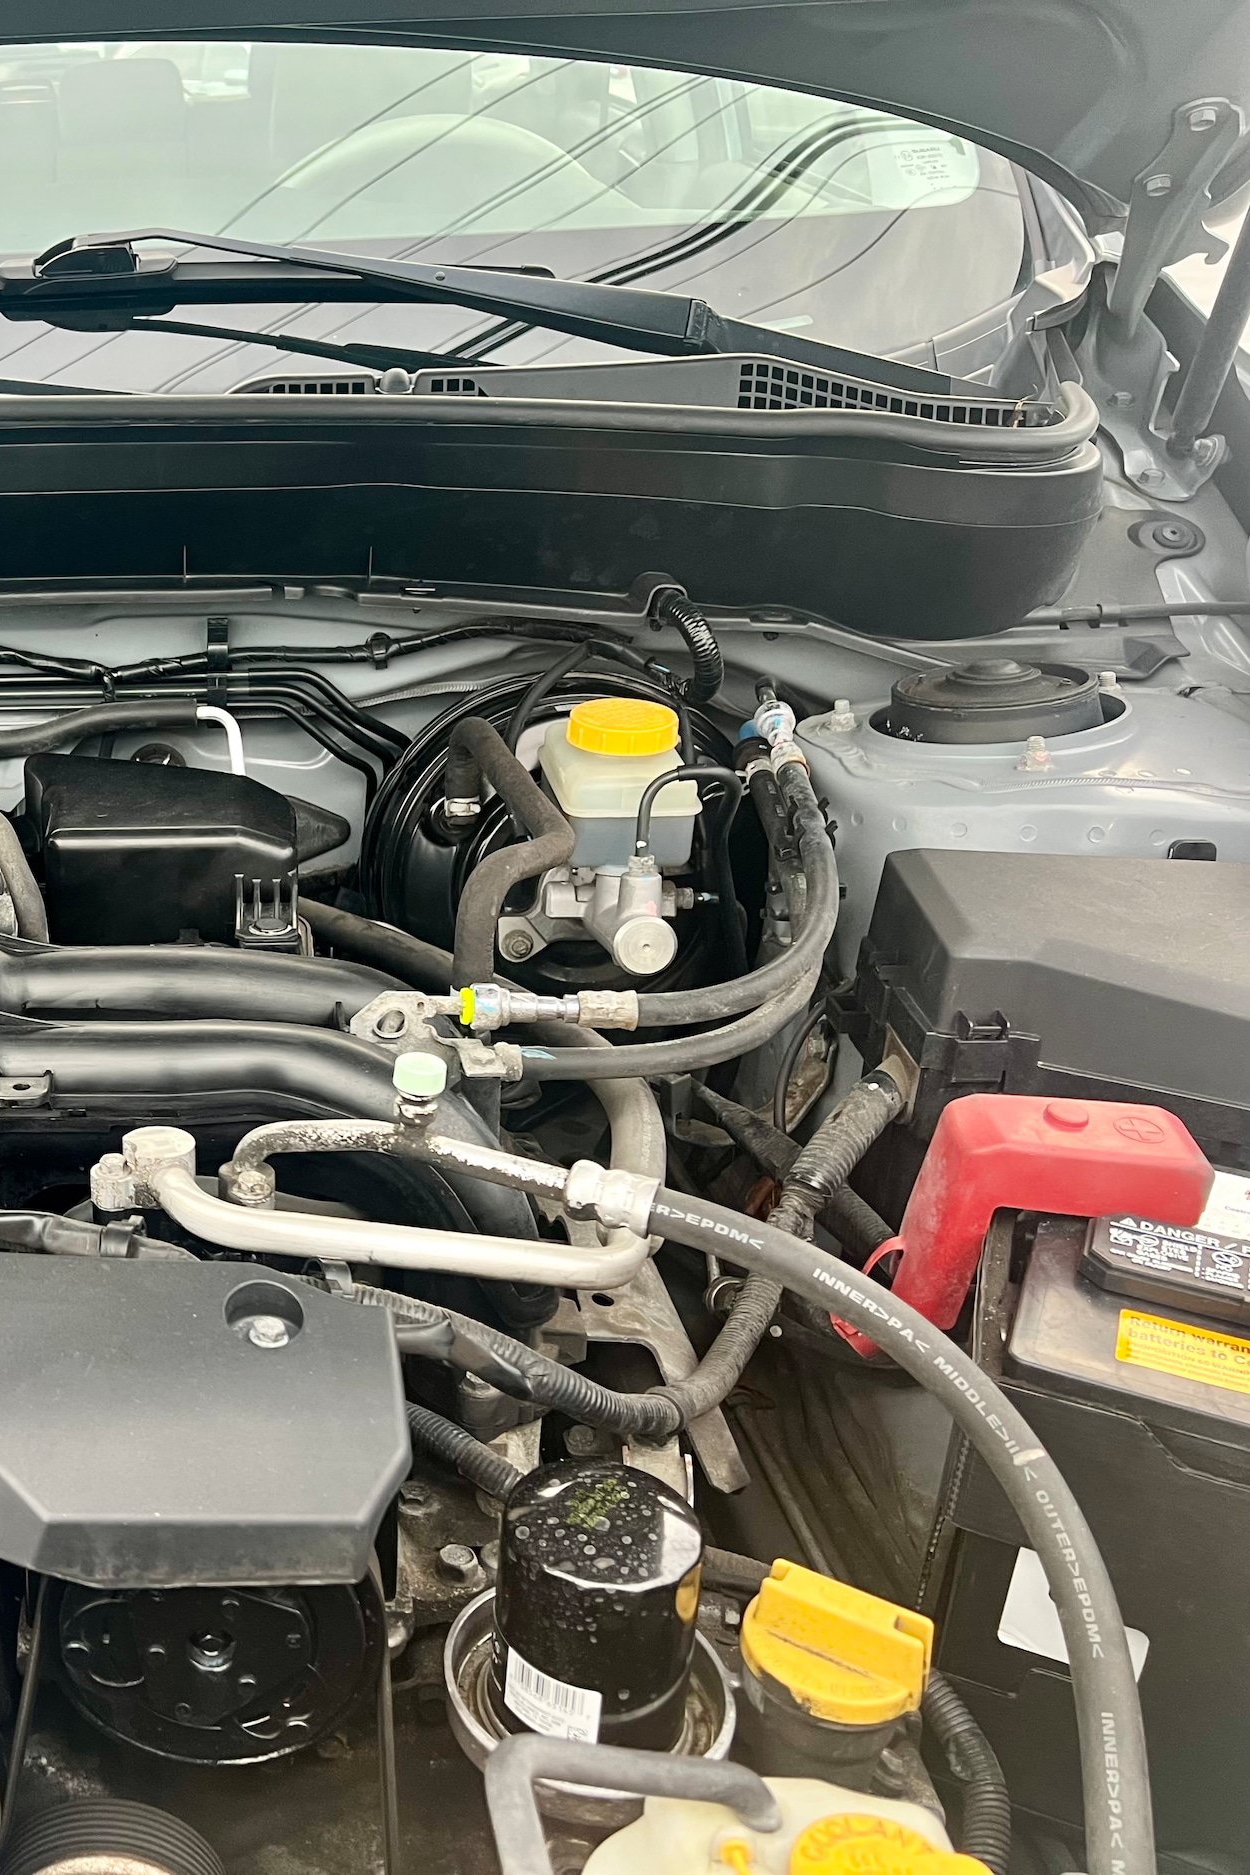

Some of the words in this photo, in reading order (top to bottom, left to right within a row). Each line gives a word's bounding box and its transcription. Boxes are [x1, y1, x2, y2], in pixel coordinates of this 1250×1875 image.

[1140, 1220, 1220, 1248] DANGER
[812, 1268, 930, 1353] INNER>PA<
[1130, 1316, 1186, 1338] Return
[1129, 1327, 1206, 1355] batteries
[1211, 1350, 1227, 1360] to
[1100, 1711, 1125, 1848] INNER>PA<
